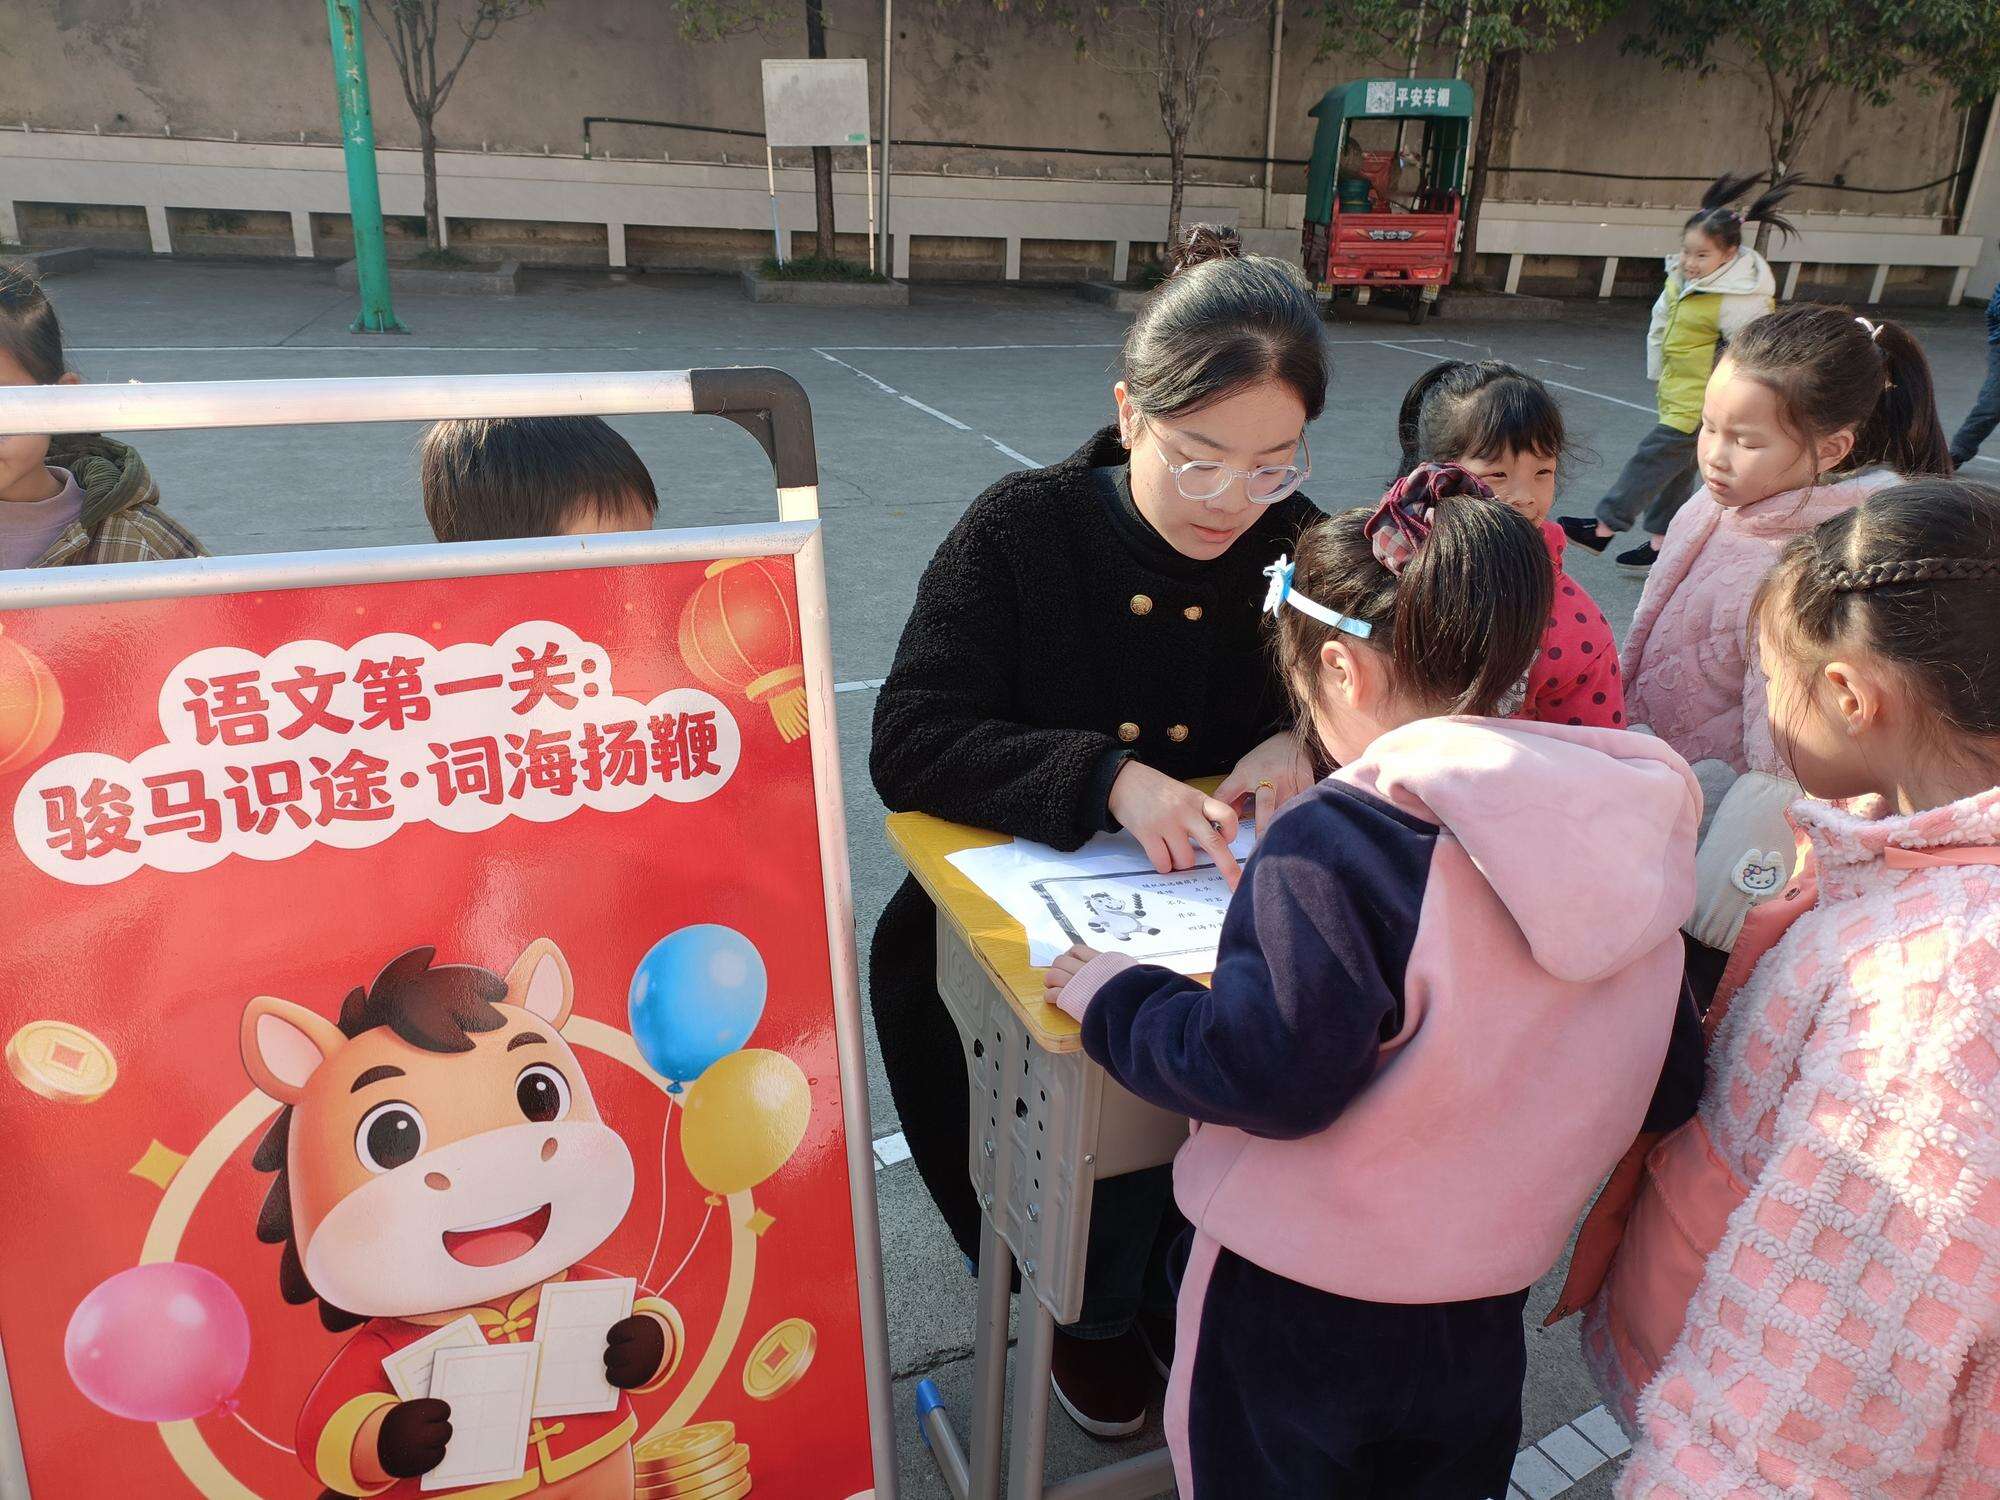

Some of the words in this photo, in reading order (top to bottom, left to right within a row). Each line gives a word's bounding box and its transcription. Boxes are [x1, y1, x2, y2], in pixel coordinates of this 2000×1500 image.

[184, 642, 598, 746] 语文第一关：
[39, 710, 722, 861] 骏马识途·词海扬鞭
